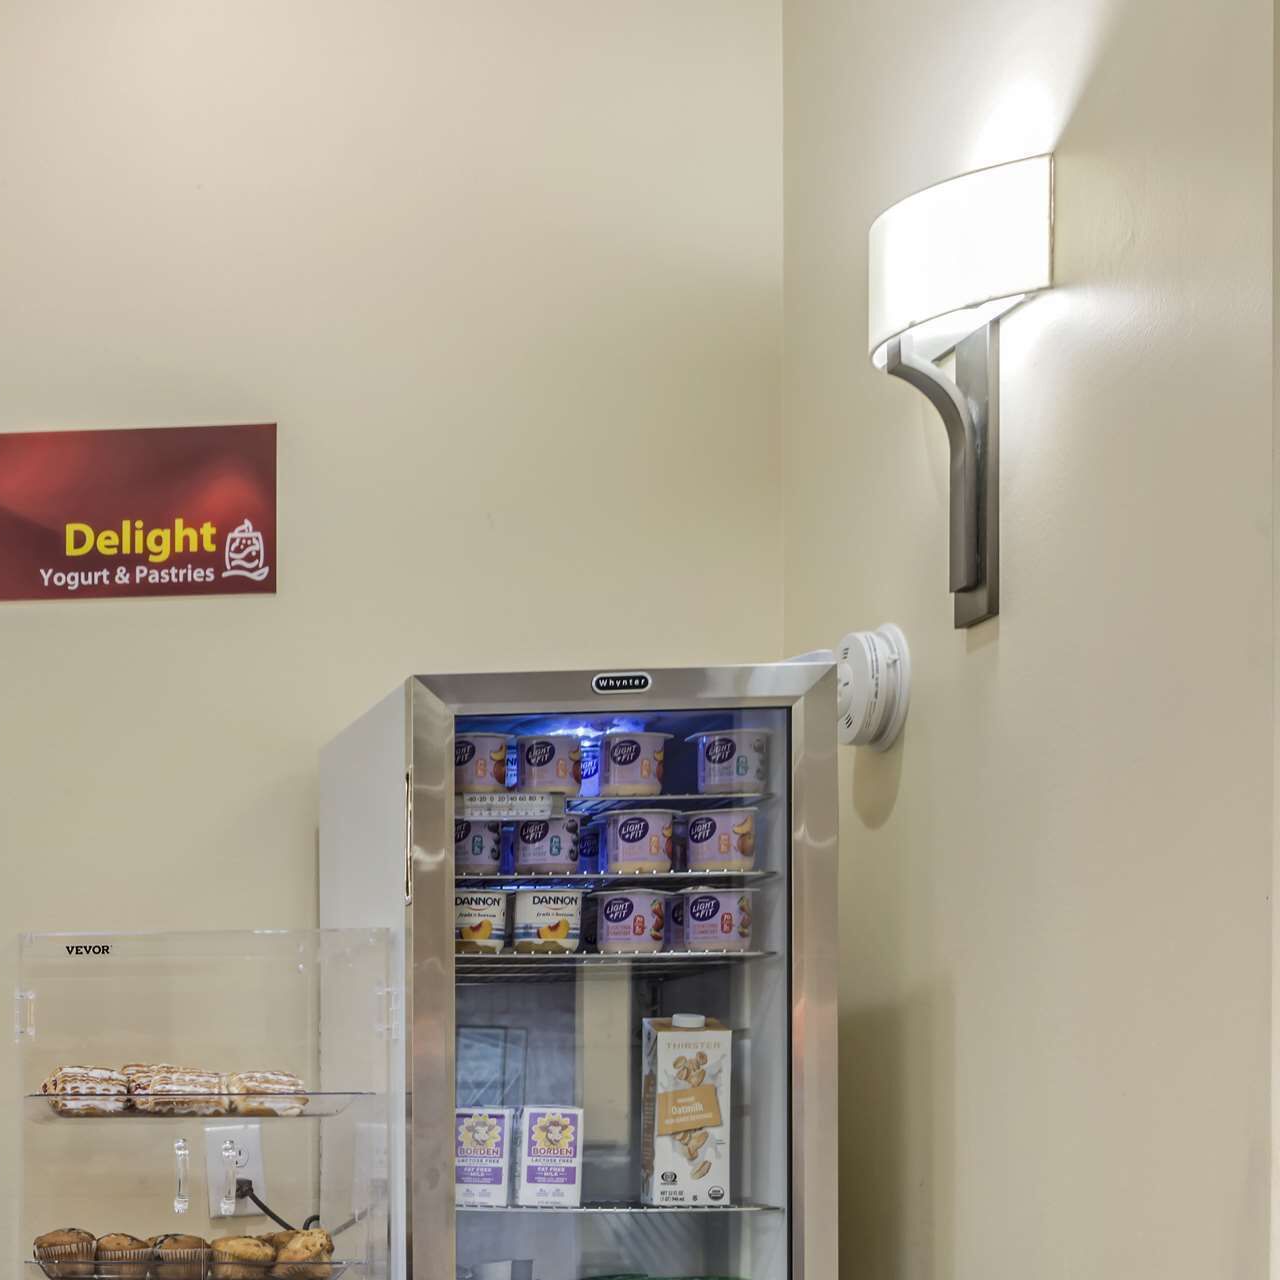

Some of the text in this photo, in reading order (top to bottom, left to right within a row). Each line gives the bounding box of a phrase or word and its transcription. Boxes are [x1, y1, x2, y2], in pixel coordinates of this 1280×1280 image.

[65, 517, 217, 563] Delight
[39, 564, 215, 591] Yogurt & Pastries
[598, 678, 646, 688] Whynter
[621, 822, 645, 834] LIGHT
[691, 822, 713, 834] LIGHT
[532, 895, 579, 905] DANNON
[606, 903, 630, 914] LIGHT
[693, 902, 716, 912] LIGHT
[65, 945, 110, 955] VEVOR
[459, 1147, 499, 1156] BORDEN
[533, 1147, 572, 1155] BORDEN
